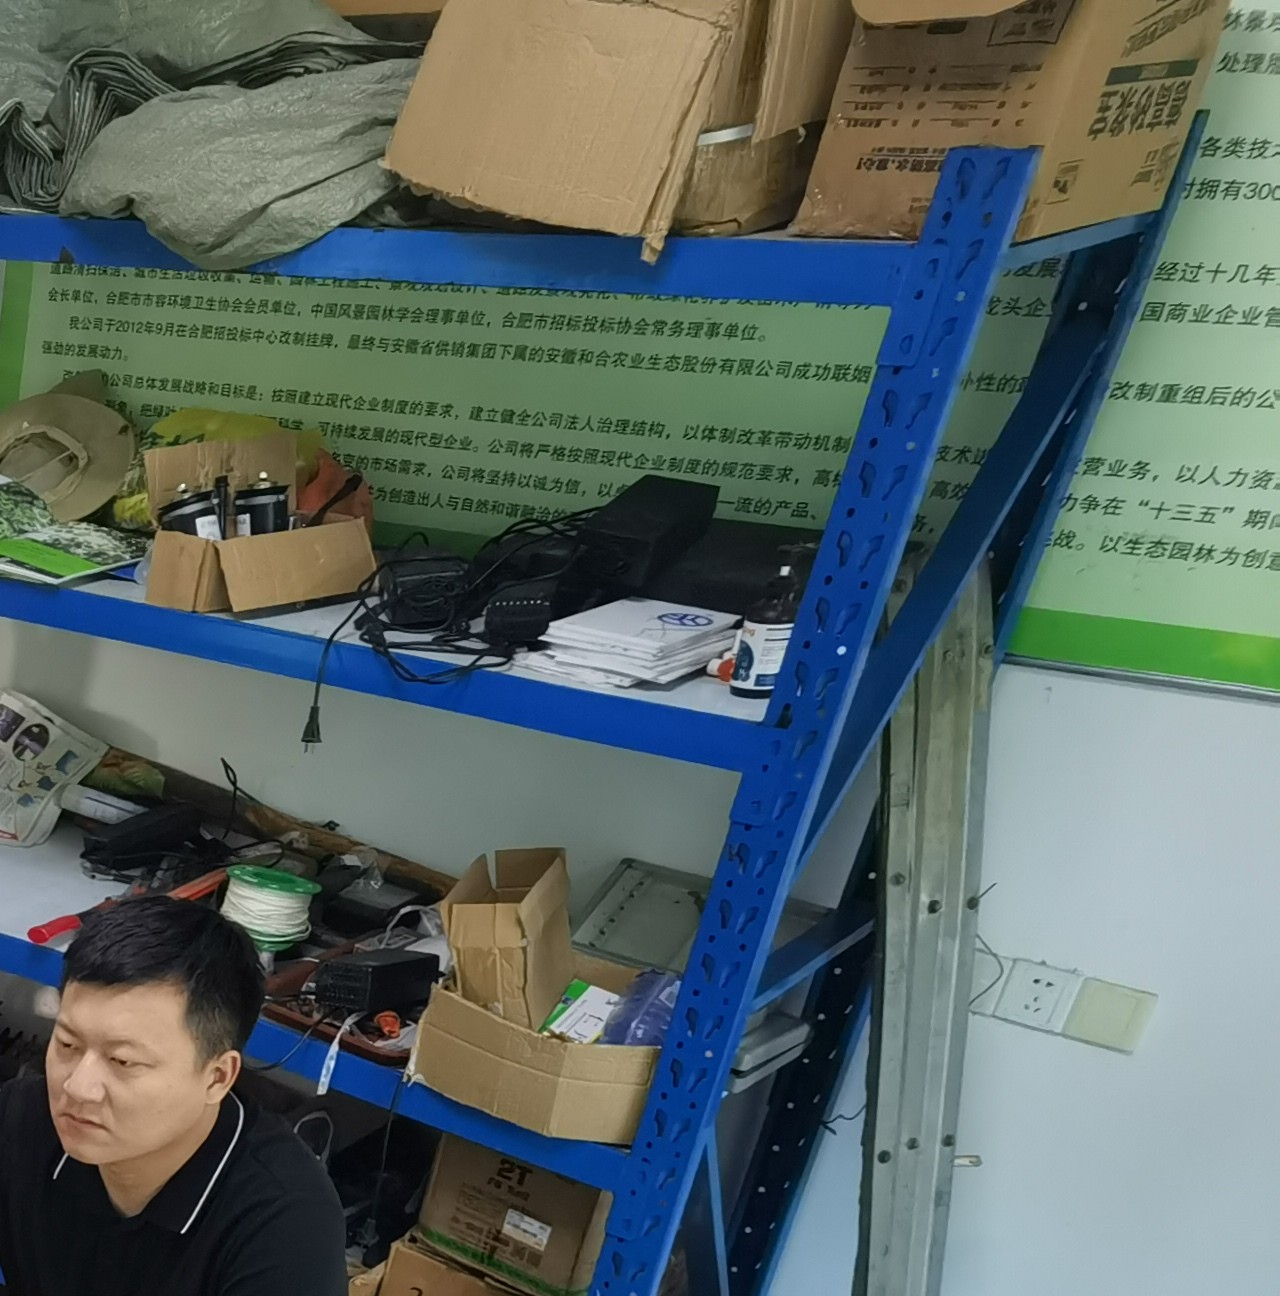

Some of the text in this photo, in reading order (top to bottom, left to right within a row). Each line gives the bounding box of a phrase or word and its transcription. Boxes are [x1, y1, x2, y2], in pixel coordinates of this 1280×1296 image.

[1108, 381, 1280, 410] 改制重组后的公
[1073, 456, 1280, 491] 营业务，以人力资
[496, 1157, 534, 1187] 2T
